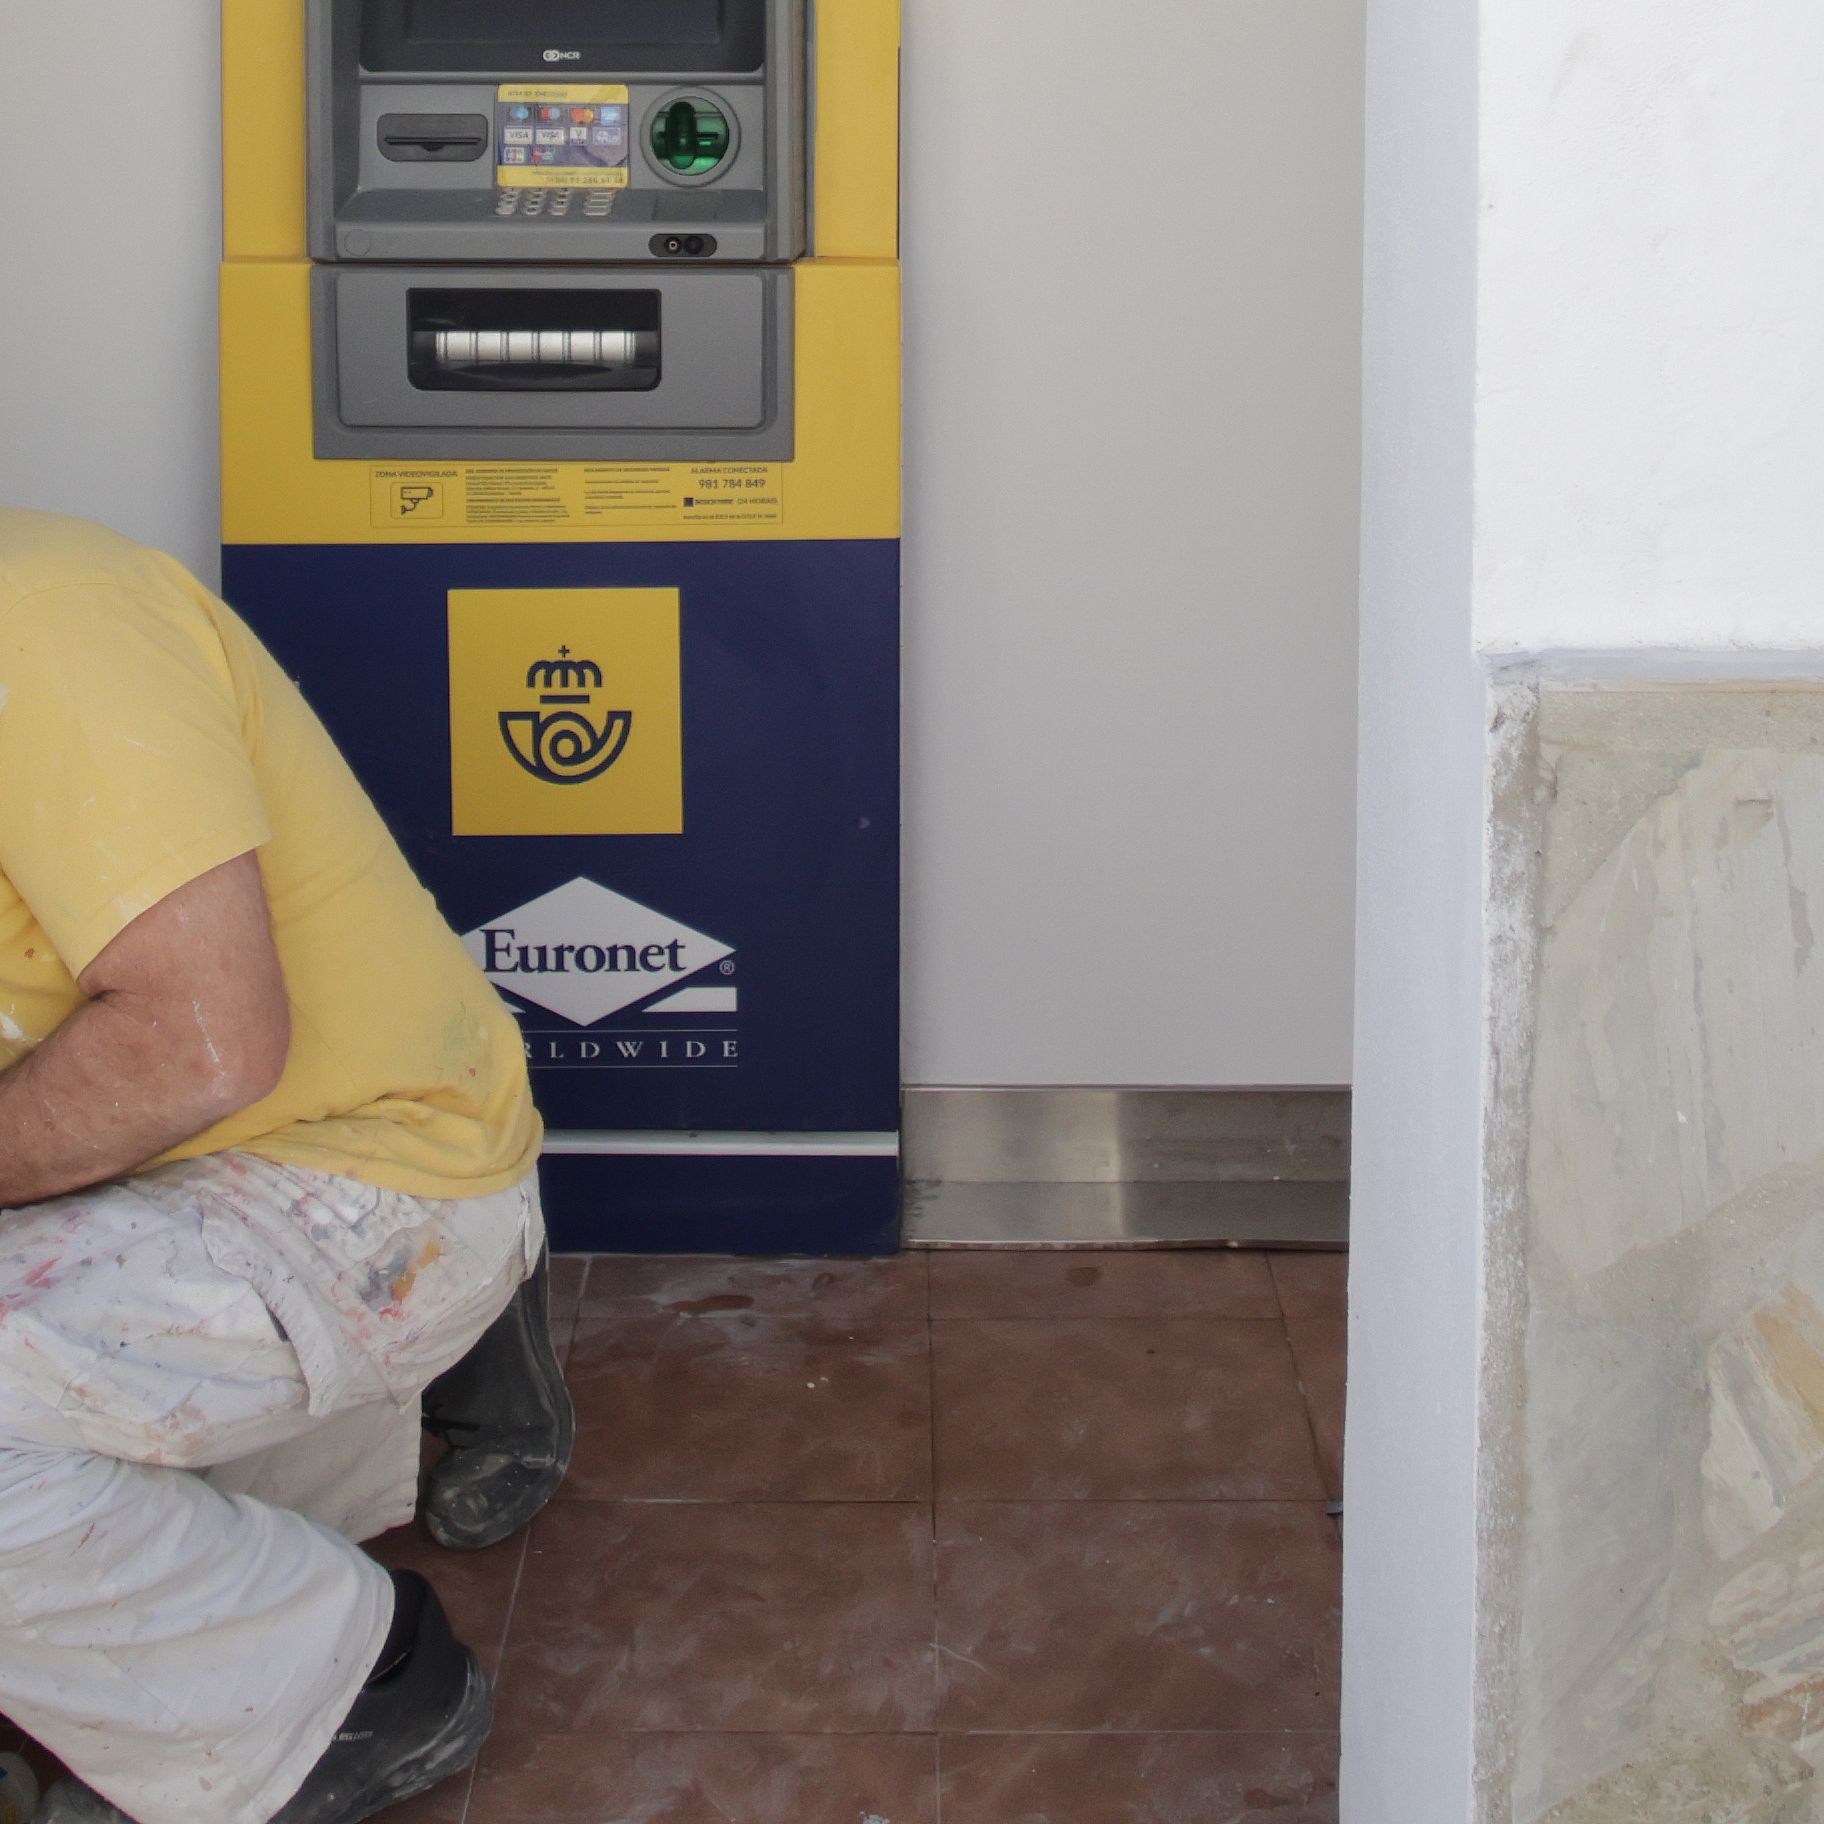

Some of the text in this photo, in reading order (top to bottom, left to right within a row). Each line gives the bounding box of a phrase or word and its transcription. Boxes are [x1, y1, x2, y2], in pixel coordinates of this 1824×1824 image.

[559, 51, 581, 60] NCR
[509, 131, 529, 139] VISA
[375, 470, 397, 478] ZONA
[698, 479, 718, 489] 981
[480, 929, 687, 973] Euronet
